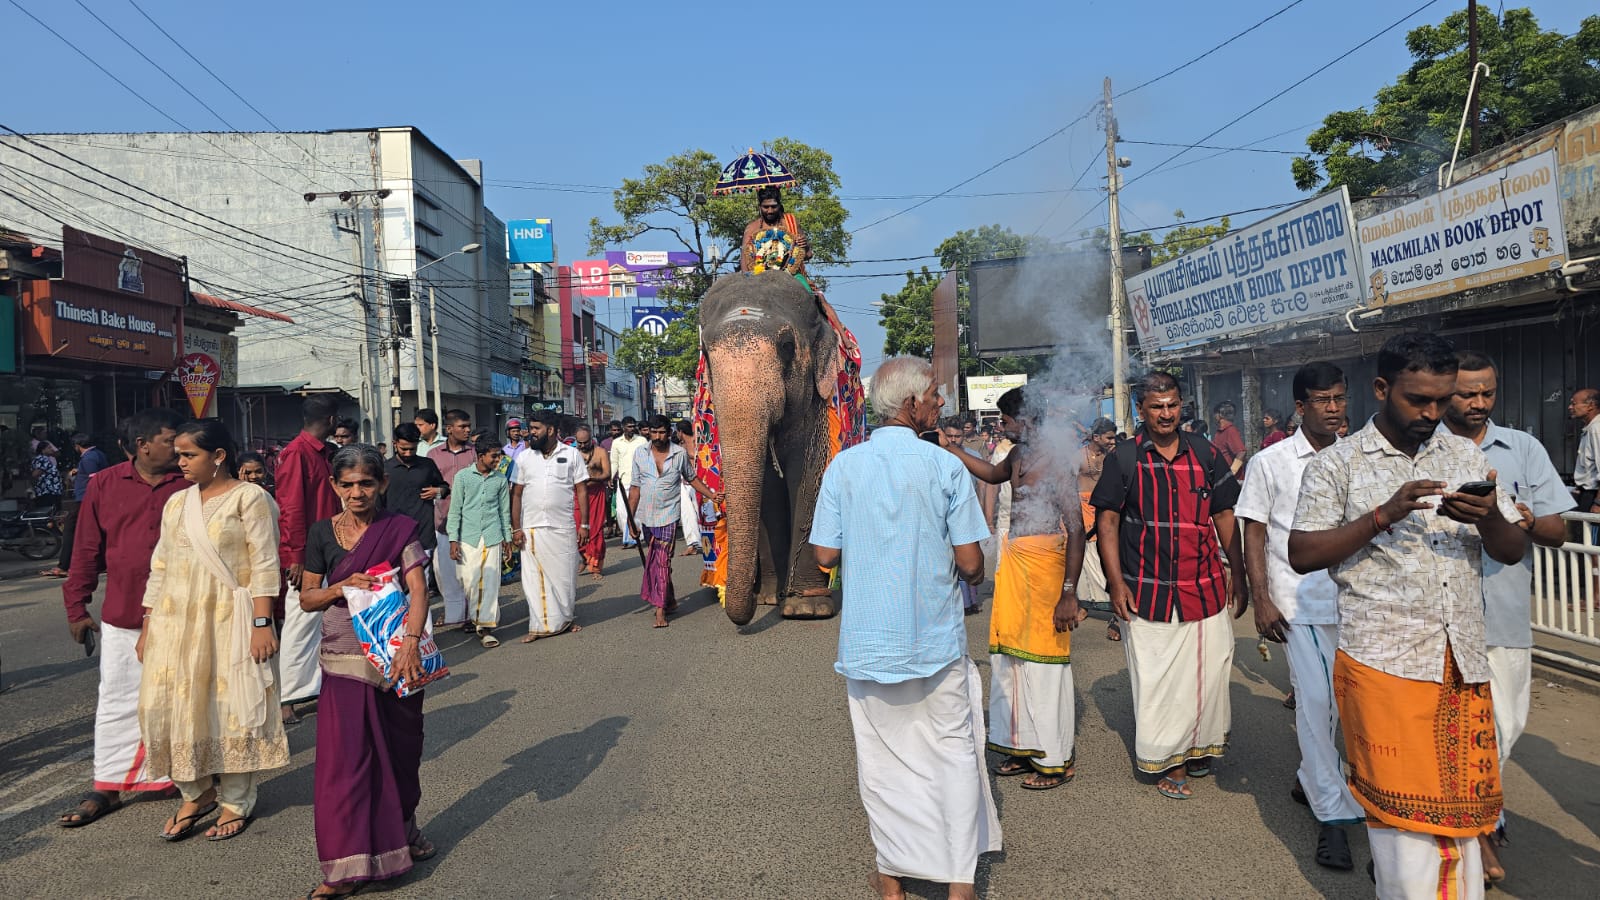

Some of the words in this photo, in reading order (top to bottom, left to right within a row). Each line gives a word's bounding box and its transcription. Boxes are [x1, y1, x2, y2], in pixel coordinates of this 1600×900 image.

[514, 228, 544, 239] HNB
[1222, 202, 1344, 279] புத்தகசாலை
[1371, 231, 1440, 269] MACKMILAN
[1445, 218, 1486, 248] BOOK
[1490, 200, 1543, 236] DEPOT
[578, 267, 603, 284] LB
[1150, 281, 1245, 327] POOBALASINGHAM
[1247, 268, 1282, 300] BOOK
[1288, 249, 1347, 290] DEPOT
[55, 300, 99, 326] Thinesh
[101, 309, 126, 330] Bake
[128, 314, 156, 334] House
